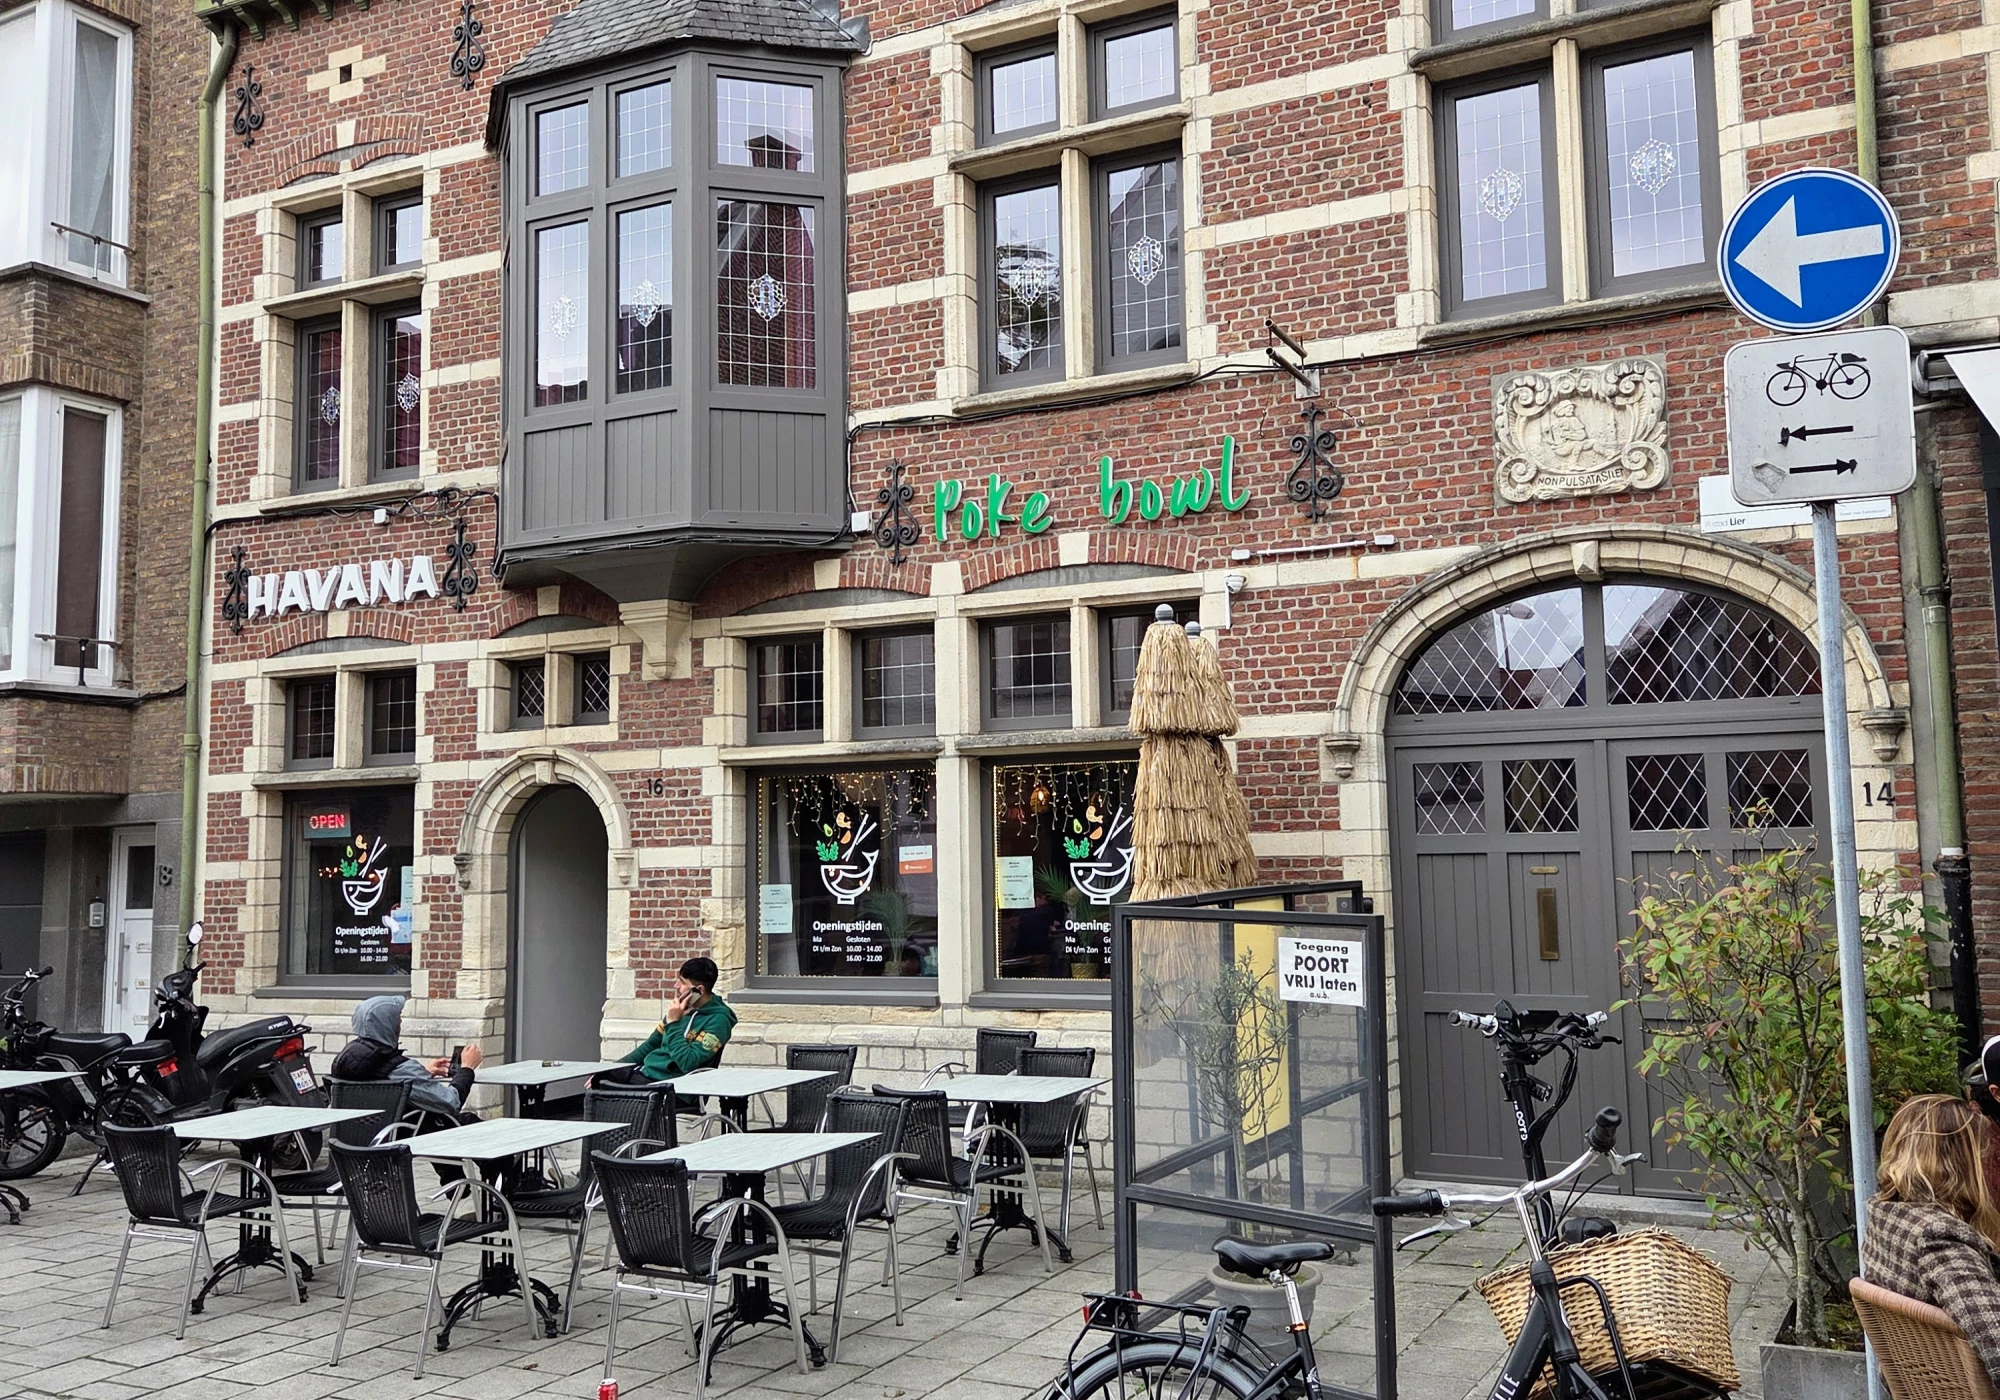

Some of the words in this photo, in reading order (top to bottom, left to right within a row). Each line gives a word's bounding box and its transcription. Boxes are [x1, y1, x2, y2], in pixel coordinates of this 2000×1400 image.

[934, 472, 1053, 542] Poke
[1100, 434, 1251, 525] bowl
[1729, 517, 1746, 526] Lier
[248, 555, 440, 620] HAVANA
[647, 778, 663, 796] 16
[1863, 781, 1896, 806] 14
[309, 814, 345, 829] OPEN
[335, 925, 389, 937] Openingstijden
[812, 920, 883, 934] Openingstijden
[812, 935, 823, 943] Ma
[845, 935, 871, 943] Gesloten
[1065, 935, 1076, 943] Ma
[820, 944, 831, 953] t/m
[846, 945, 862, 953] 10.00
[866, 945, 883, 953] 14.00
[1073, 945, 1086, 954] t/m
[1294, 942, 1349, 954] Toegang
[846, 954, 862, 962] 16.00
[866, 954, 883, 962] 22.00
[1294, 955, 1349, 973] POORT
[1284, 974, 1315, 989] VRIJ
[1320, 976, 1357, 992] laten
[1309, 991, 1330, 1000] a.u.b.
